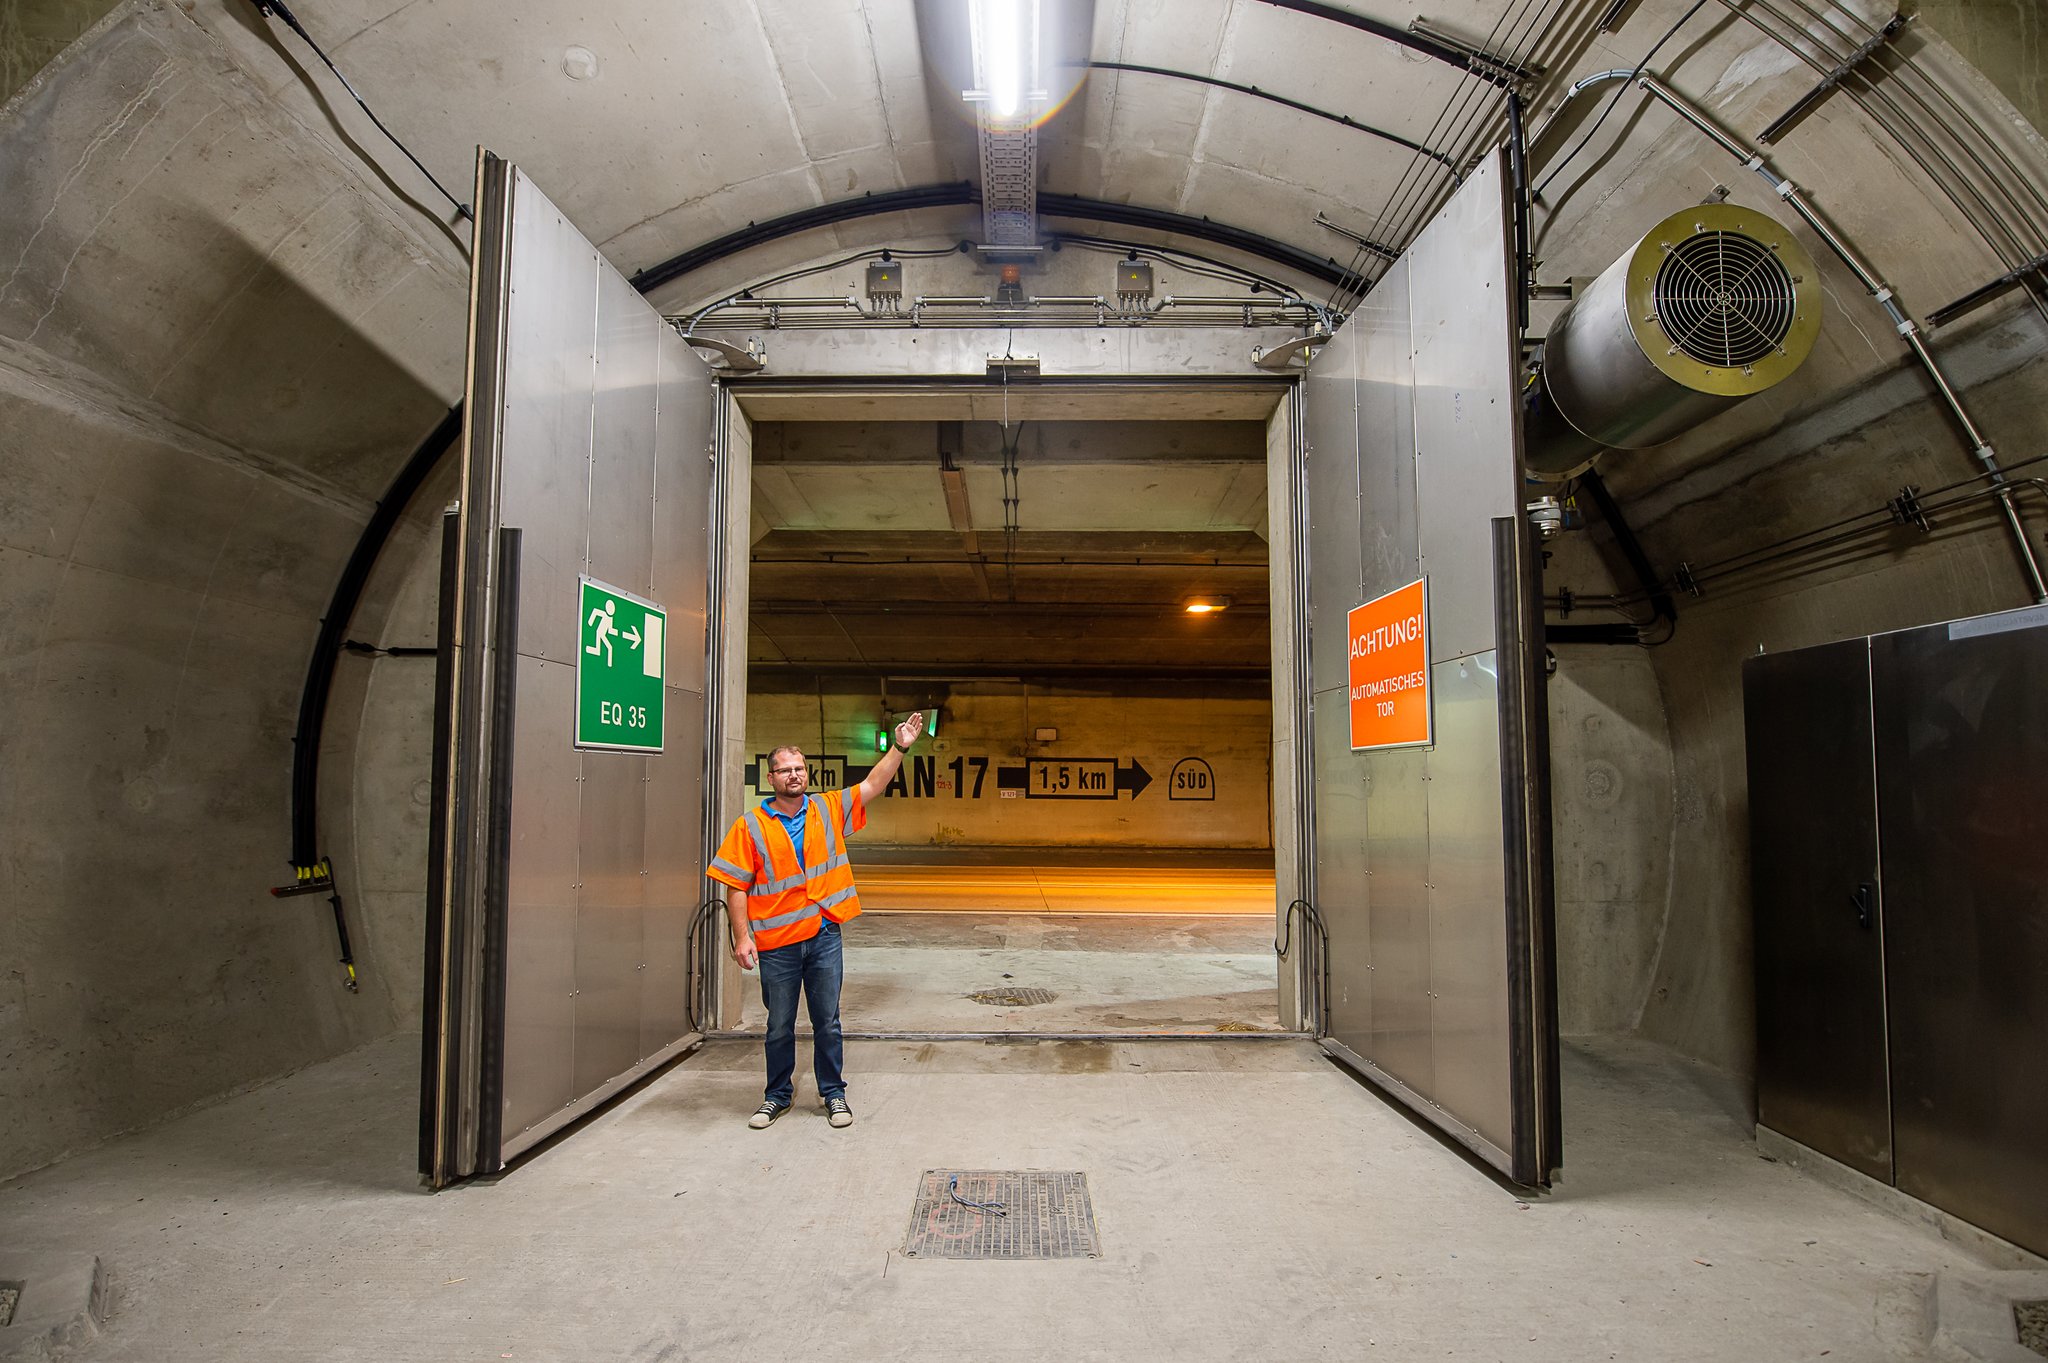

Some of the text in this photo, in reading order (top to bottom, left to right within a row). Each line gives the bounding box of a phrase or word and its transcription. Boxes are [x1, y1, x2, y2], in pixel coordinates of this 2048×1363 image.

[1350, 613, 1422, 660] ACHTUNG!
[1351, 670, 1424, 701] AUTOMATISCHES
[601, 700, 646, 729] EQ 35
[1376, 700, 1394, 718] TOR
[808, 764, 836, 787] km
[948, 755, 989, 798] 17
[1039, 766, 1106, 793] 1,5 km
[1177, 768, 1207, 789] SÜD
